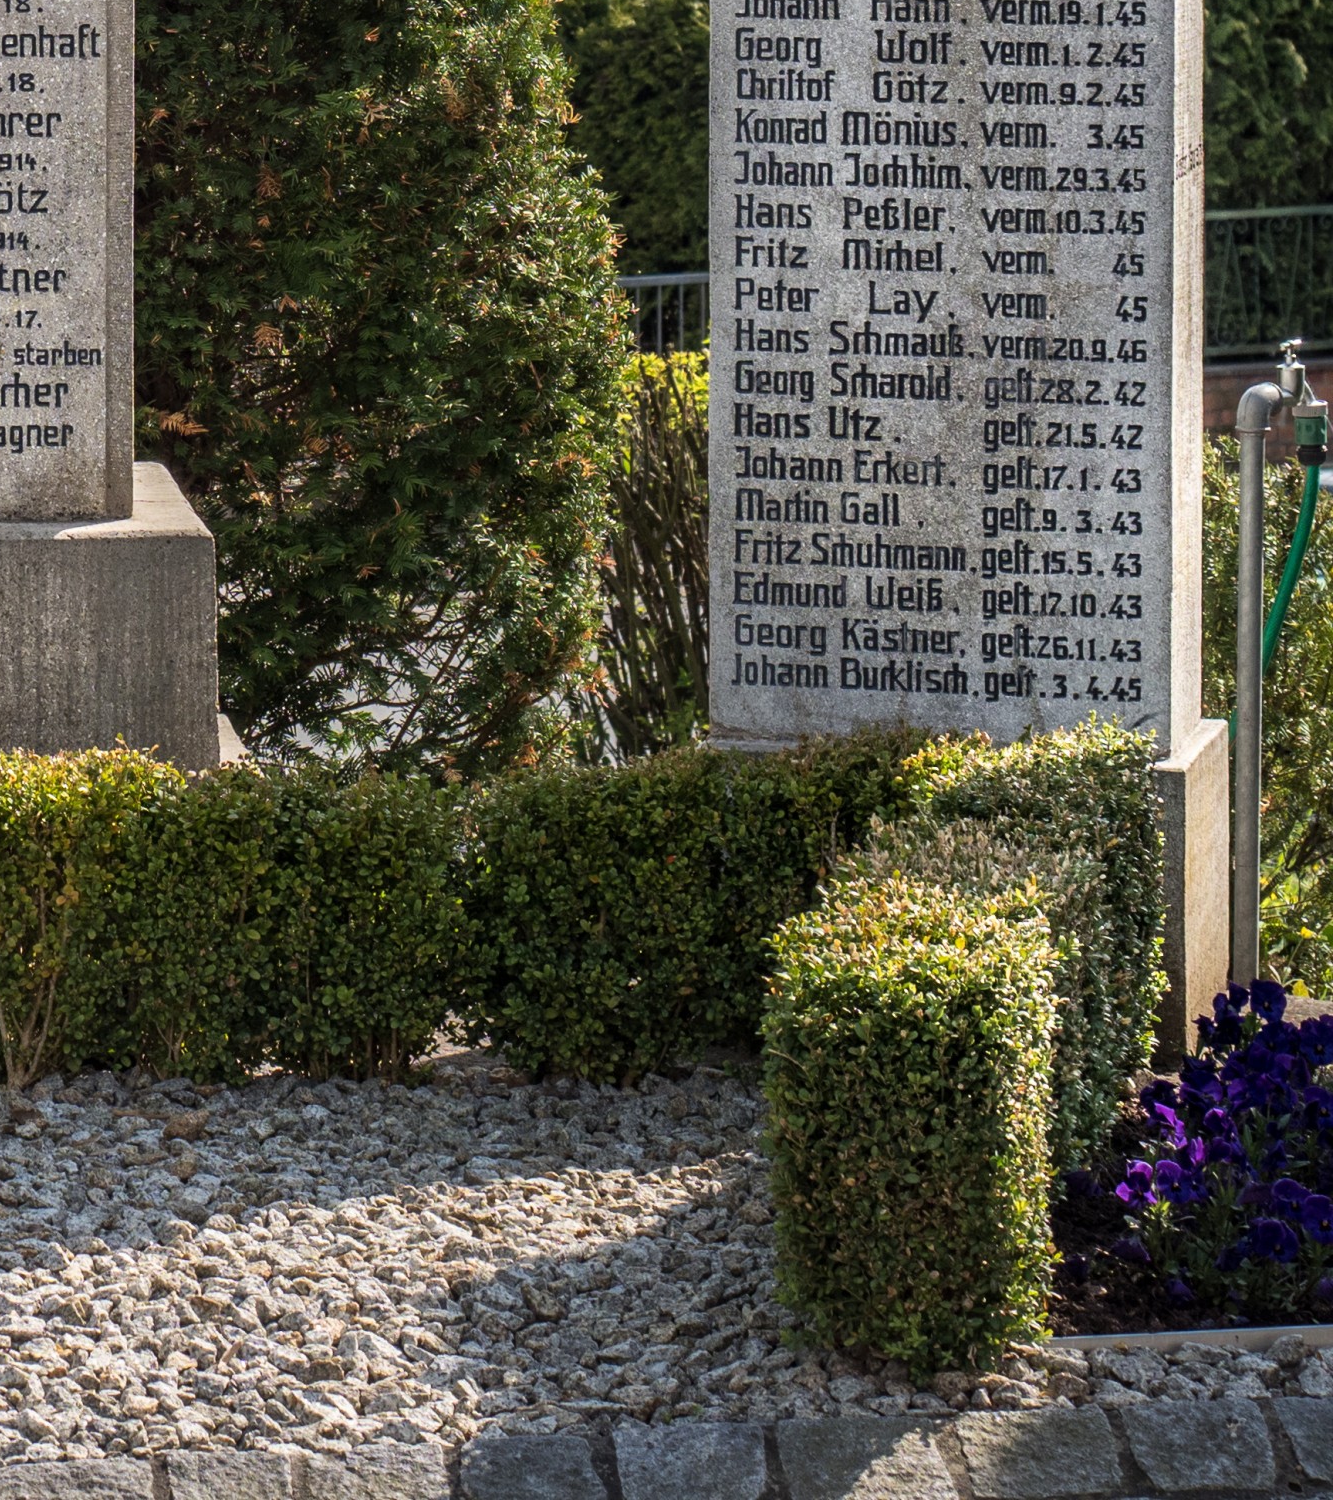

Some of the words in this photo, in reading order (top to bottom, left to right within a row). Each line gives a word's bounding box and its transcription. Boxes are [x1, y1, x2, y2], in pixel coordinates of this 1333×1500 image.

[736, 28, 821, 68] Georg
[737, 109, 826, 144] Konrad
[736, 151, 832, 186] Johann
[736, 194, 811, 228] Hans
[736, 236, 808, 269] Fritz
[735, 278, 819, 312] Peter
[14, 340, 101, 366] starben
[735, 319, 809, 353] Hans
[735, 360, 814, 403] Georg
[734, 403, 810, 438] Hans
[736, 446, 842, 482] Johann
[736, 489, 828, 523] Martin
[735, 530, 801, 565] Fritz
[734, 571, 846, 608] Edmund
[736, 615, 826, 656] Georg
[733, 654, 828, 687] Johann
